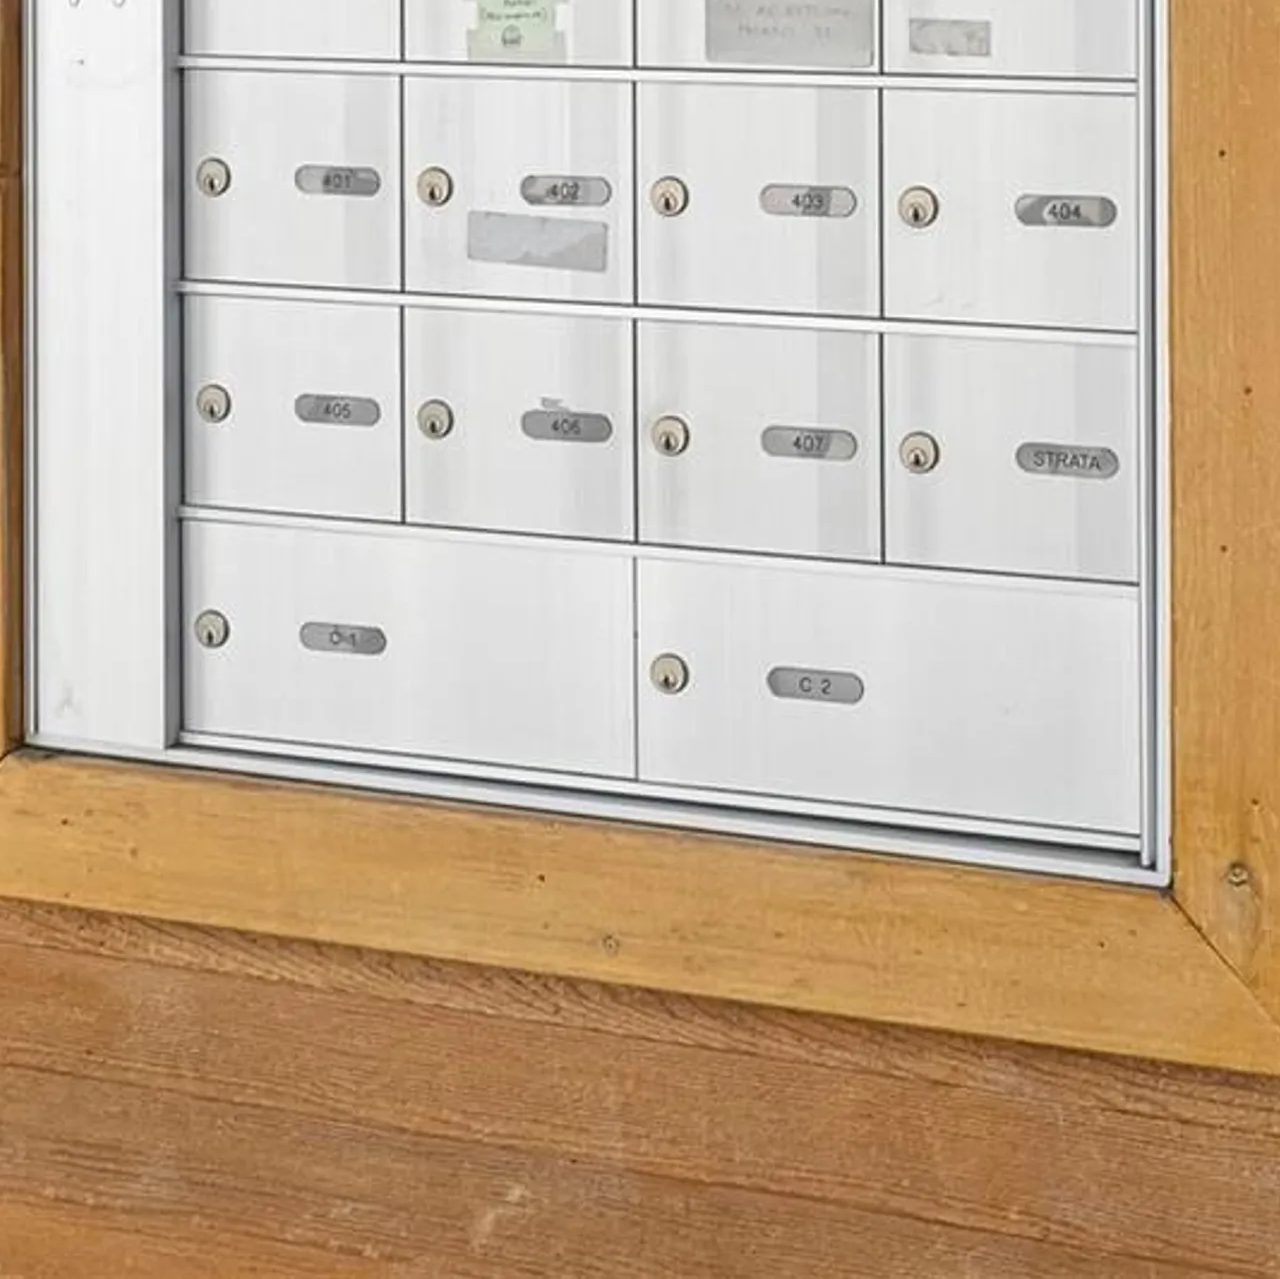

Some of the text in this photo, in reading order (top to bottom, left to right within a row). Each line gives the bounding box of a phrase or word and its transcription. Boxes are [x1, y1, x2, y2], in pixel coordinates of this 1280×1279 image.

[323, 173, 352, 189] 401
[547, 182, 579, 200] 402
[792, 193, 823, 211] 403
[1049, 202, 1081, 220] 404
[324, 403, 351, 419] 405
[550, 419, 581, 436] 406
[794, 436, 823, 453] 407
[1033, 451, 1101, 471] STRATA
[800, 677, 831, 695] C 2
